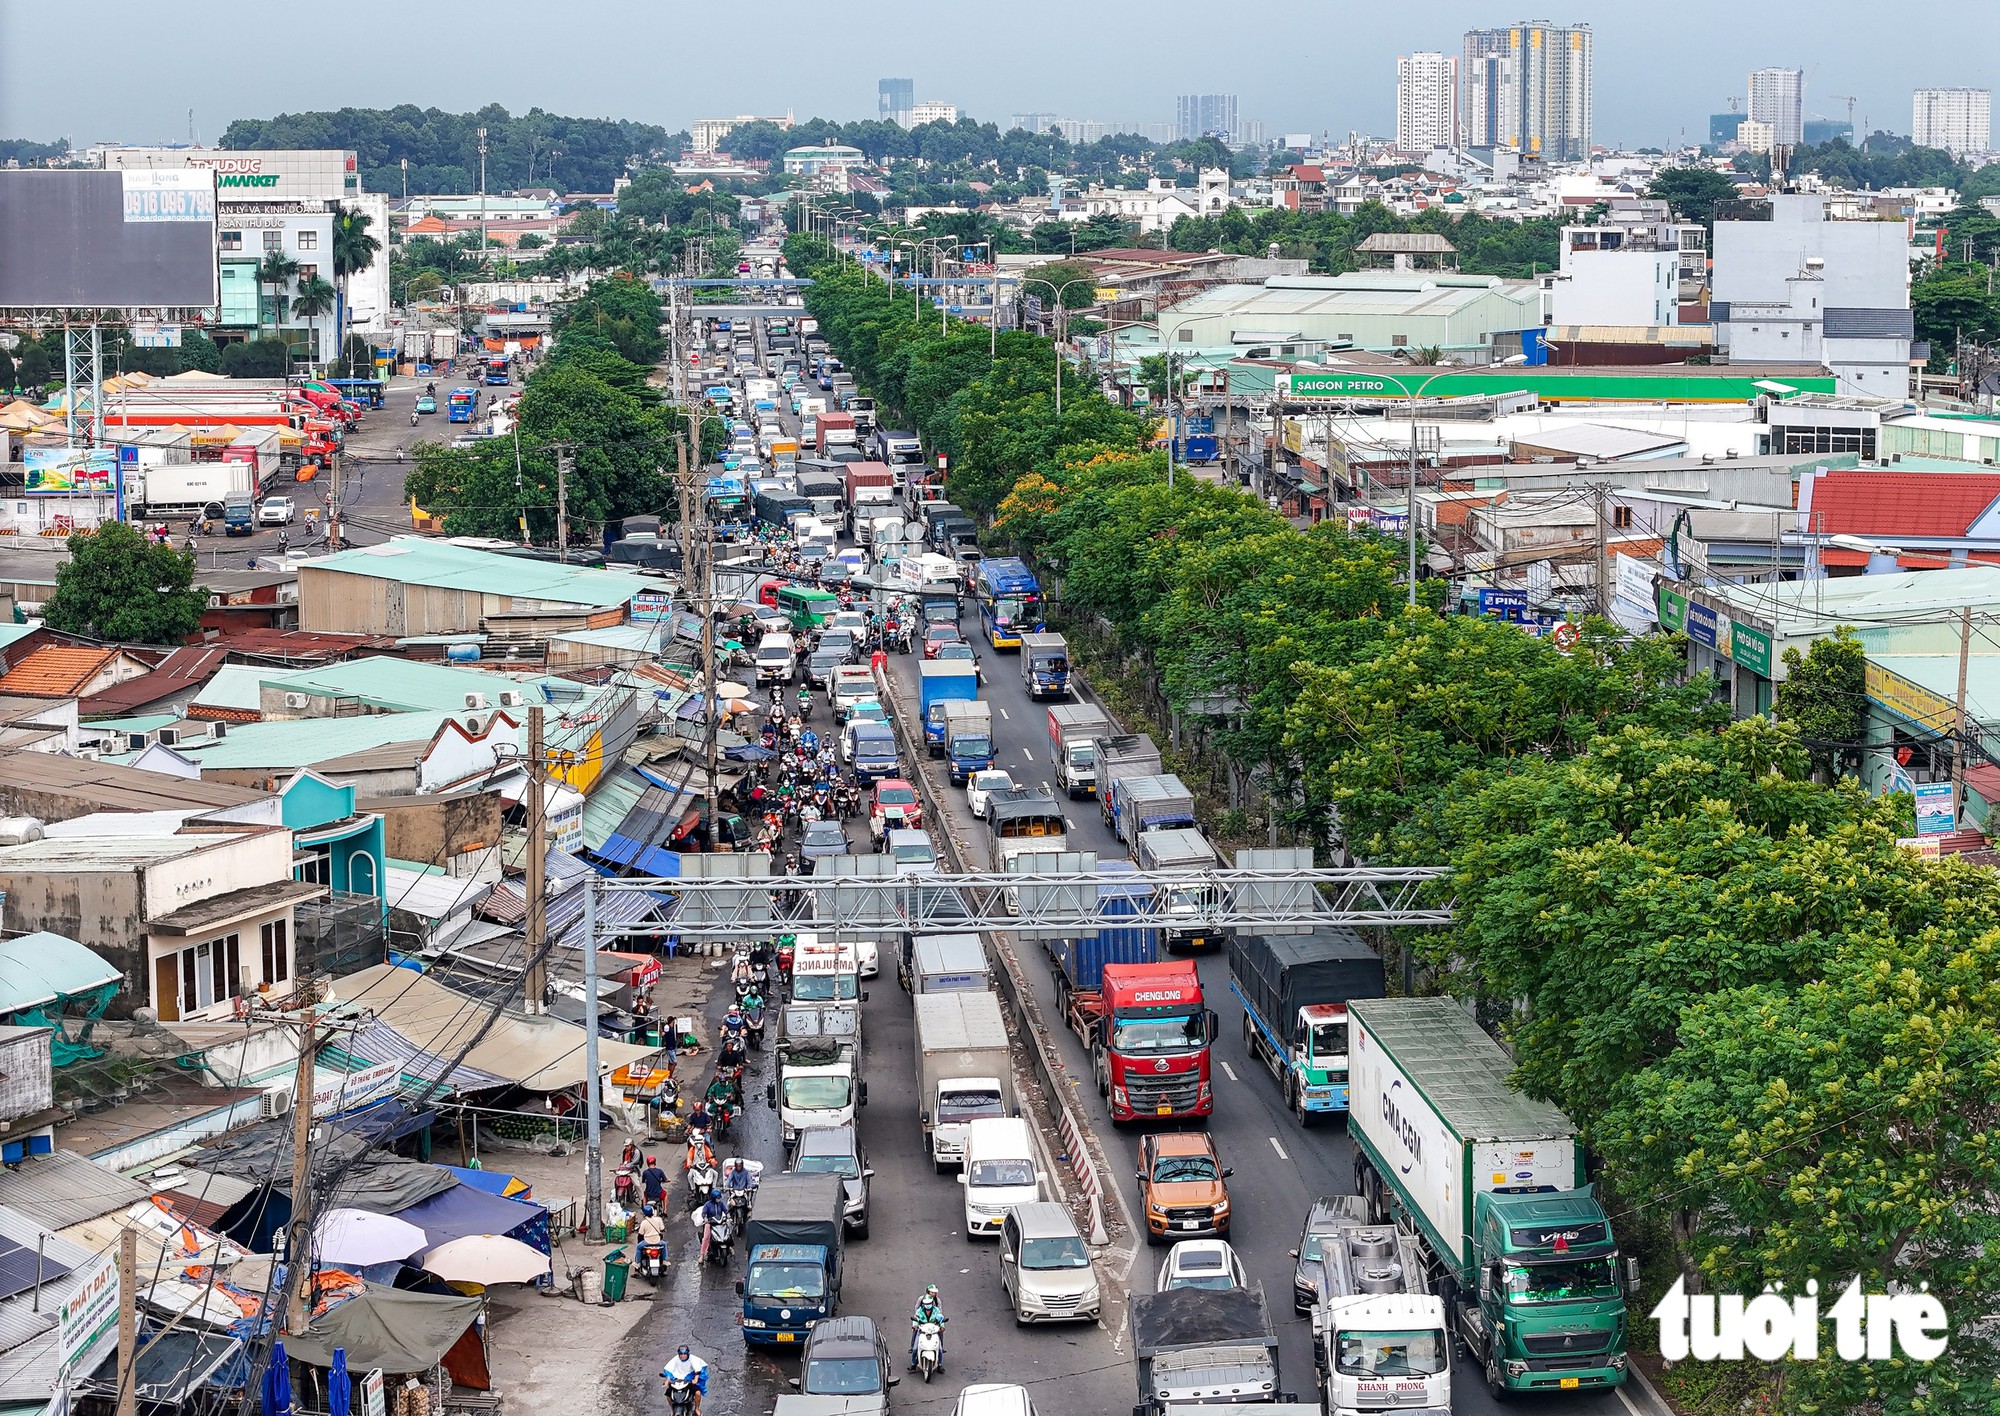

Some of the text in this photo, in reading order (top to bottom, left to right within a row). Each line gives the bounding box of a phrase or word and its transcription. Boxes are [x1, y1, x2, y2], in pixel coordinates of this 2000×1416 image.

[125, 190, 158, 214] 0916
[160, 190, 184, 214] 095
[1298, 380, 1384, 391] SAIGON PETRO
[1135, 990, 1180, 1001] CHENGLONG
[1382, 1092, 1422, 1165] CMA CGM
[70, 1265, 111, 1317] PHÁT ĐẠT
[1396, 1382, 1424, 1390] PHONG
